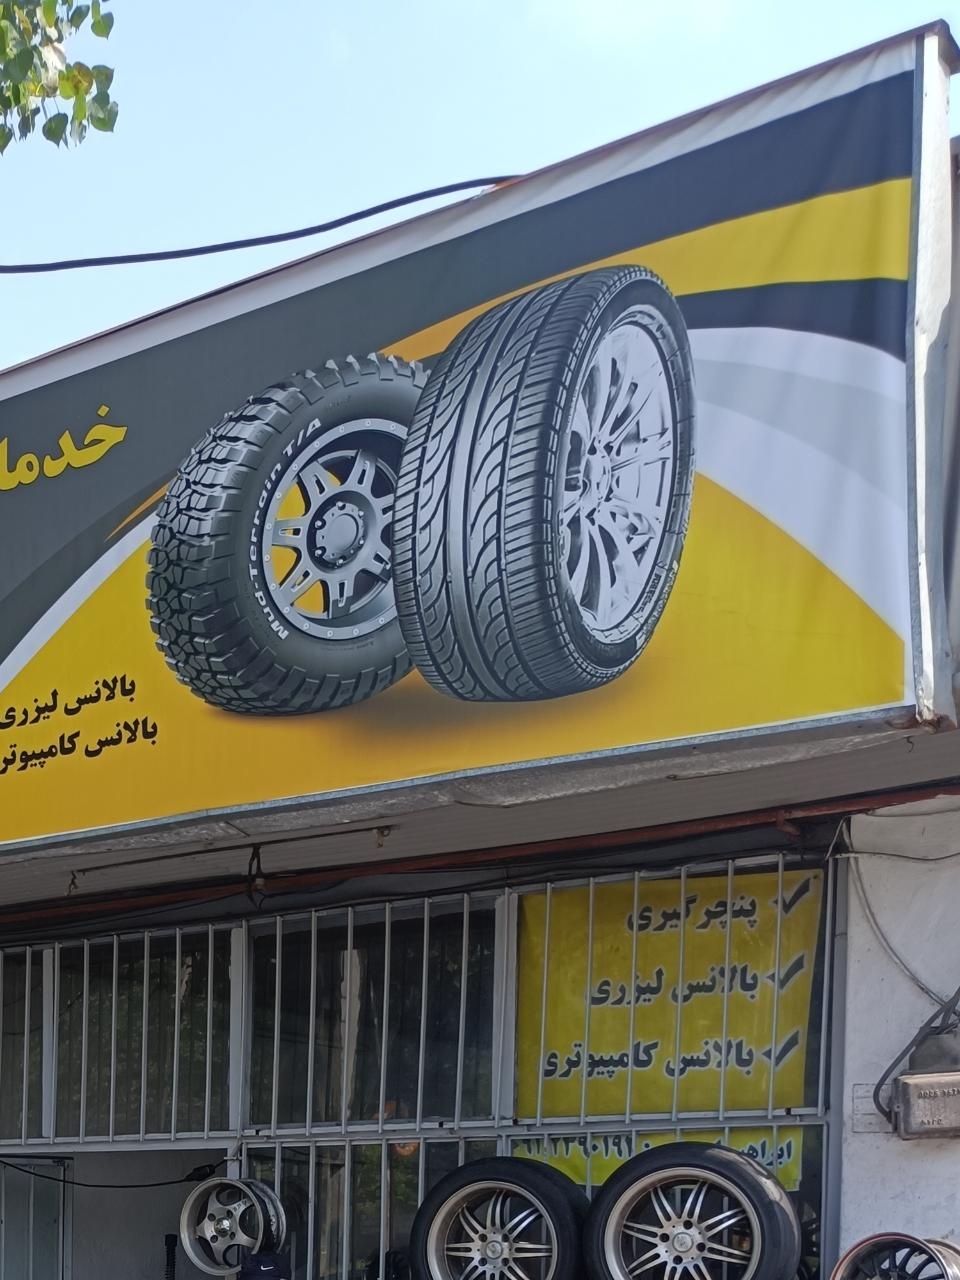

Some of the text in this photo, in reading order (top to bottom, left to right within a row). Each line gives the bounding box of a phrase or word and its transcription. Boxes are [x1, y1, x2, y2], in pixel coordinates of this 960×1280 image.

[64, 674, 136, 715] بالانس
[85, 716, 158, 757] بالانس
[586, 964, 759, 1006] بالانس لیزری
[665, 1039, 754, 1078] بالانس
[740, 1139, 792, 1167] ابراه
